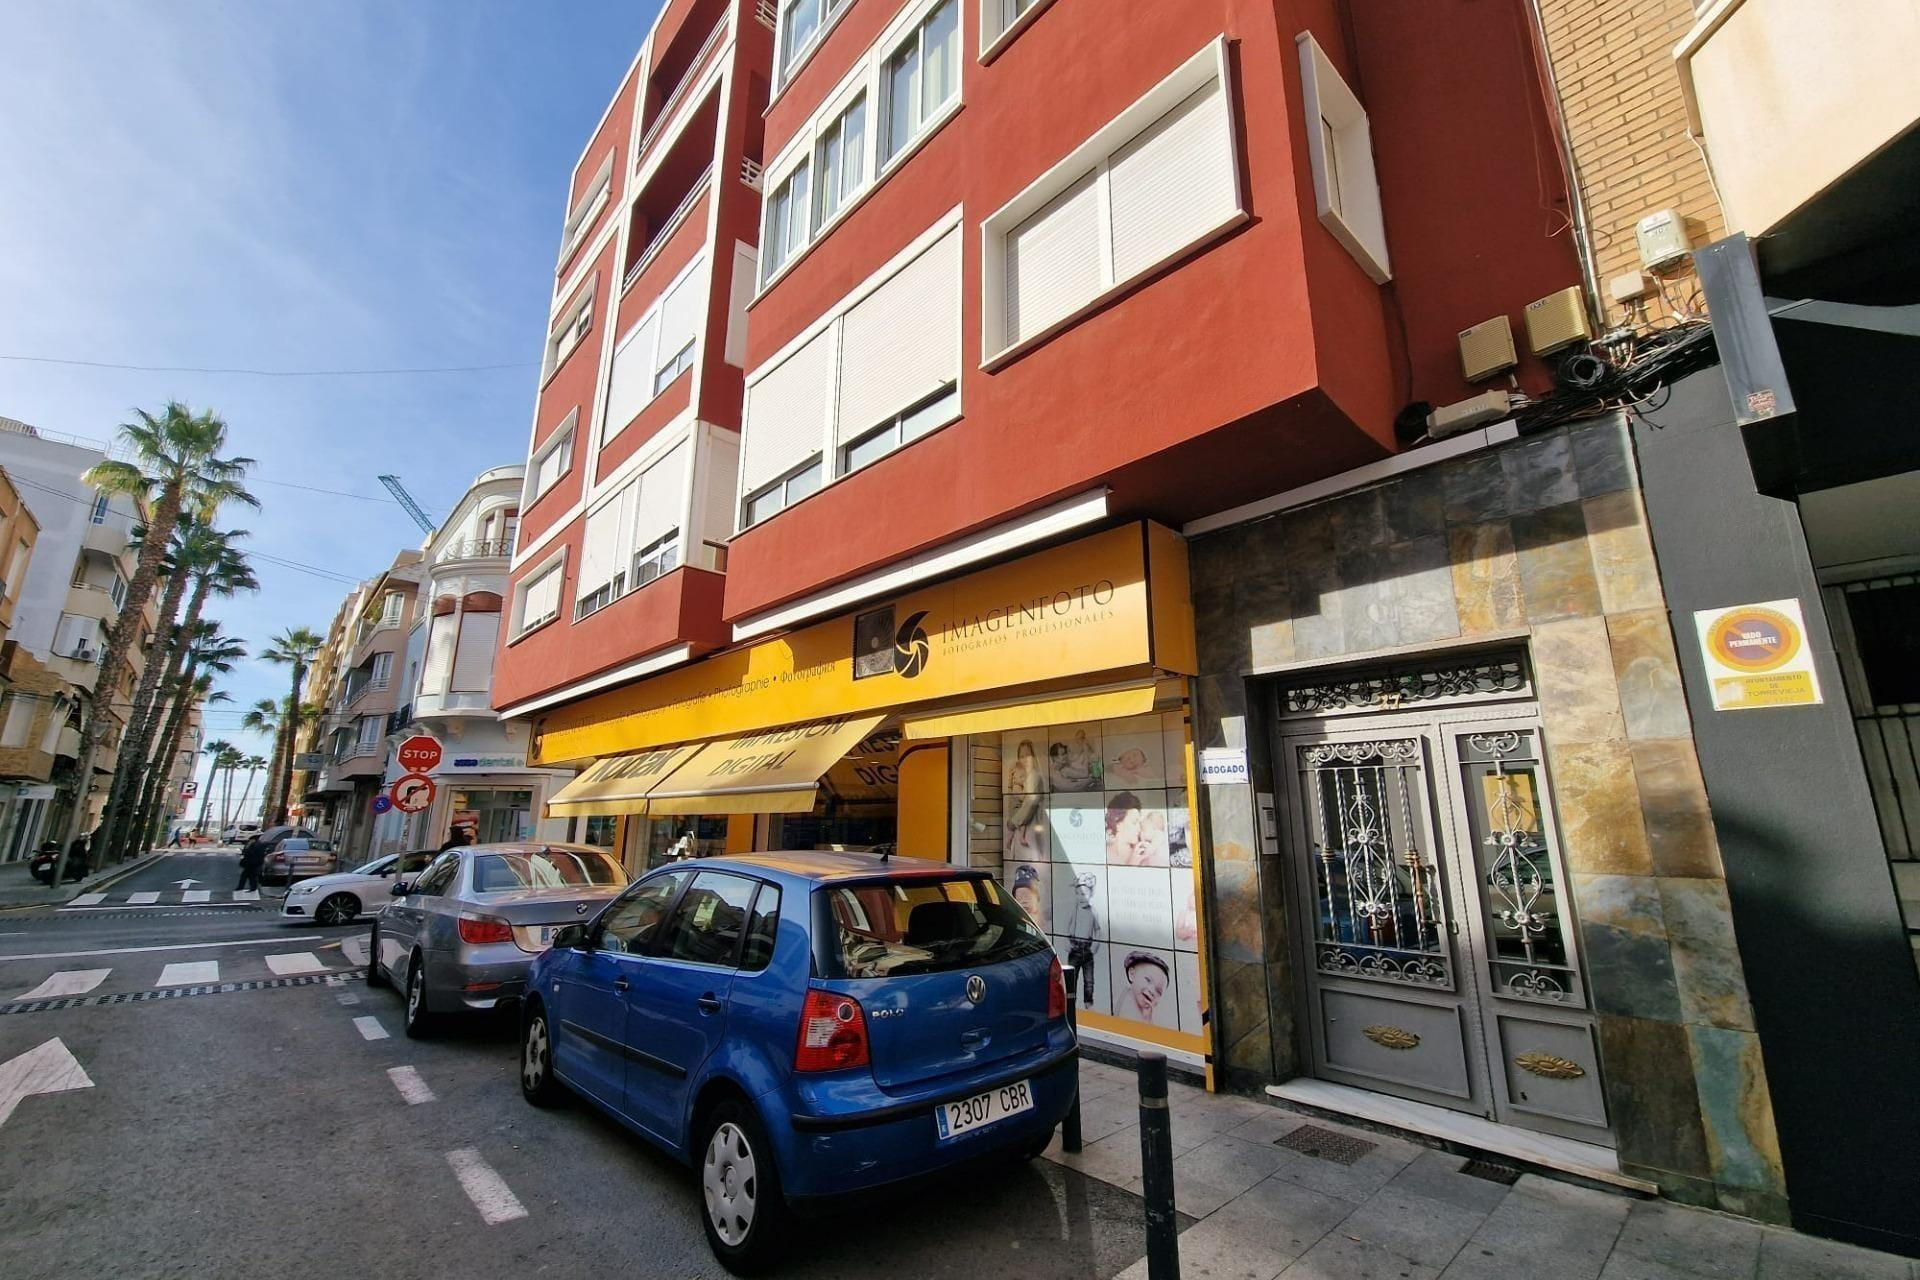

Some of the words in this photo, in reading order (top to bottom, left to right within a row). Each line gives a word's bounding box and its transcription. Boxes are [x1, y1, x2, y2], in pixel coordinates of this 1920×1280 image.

[942, 579, 1115, 644] IMAGENFOTO
[1015, 610, 1115, 642] PROFESIONALES
[1740, 631, 1762, 640] VADO
[1729, 636, 1778, 649] PERMANENTE
[713, 676, 770, 702] Photographie
[403, 750, 438, 760] STOP
[707, 749, 797, 776] DIGITAL
[1202, 764, 1245, 775] ABOGADO
[871, 1008, 904, 1019] POLO
[950, 1094, 991, 1130] 2307
[1000, 1084, 1029, 1112] CBR
